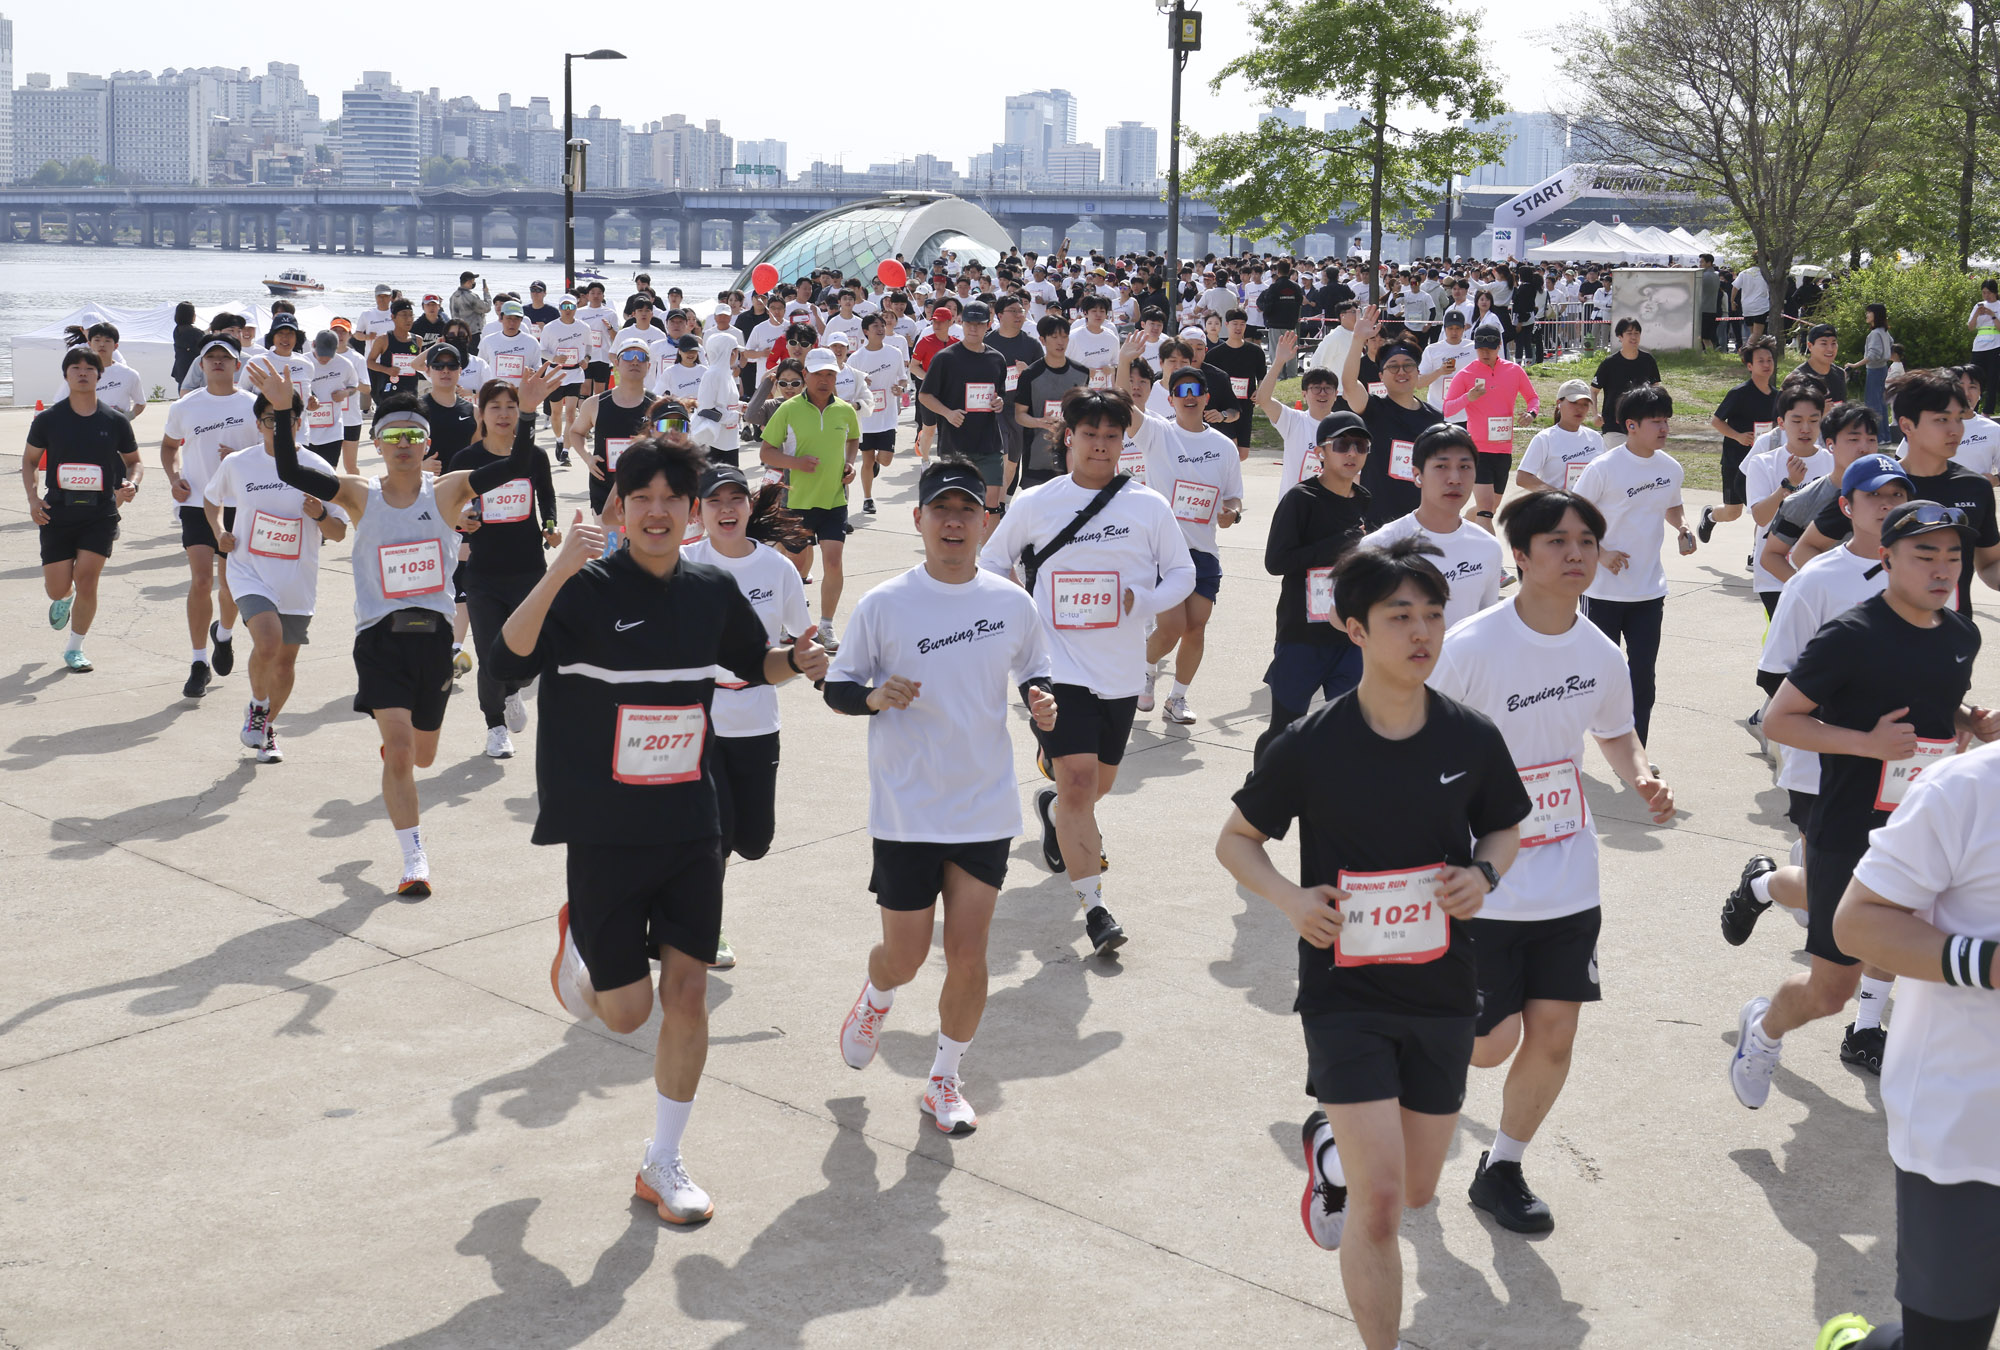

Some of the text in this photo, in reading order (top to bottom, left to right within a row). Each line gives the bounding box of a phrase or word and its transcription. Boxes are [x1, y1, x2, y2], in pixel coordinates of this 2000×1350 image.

[1512, 180, 1564, 217] START
[194, 417, 244, 435] Burning Run
[1204, 451, 1220, 459] Run
[1562, 451, 1586, 462] Burning
[1876, 458, 1893, 471] LA
[246, 482, 284, 492] Burning
[1627, 477, 1671, 497] Burning Run
[496, 494, 526, 504] 3078
[1187, 496, 1210, 507] 1248
[266, 531, 296, 542] 1208
[1103, 525, 1130, 537] Run
[400, 559, 435, 574] 1038
[1457, 562, 1482, 575] Run
[748, 588, 774, 600] Run
[1072, 593, 1111, 605] 1819
[917, 630, 975, 654] Burning
[975, 619, 1005, 636] Run
[1507, 687, 1564, 712] Burning
[1565, 675, 1597, 693] Run
[628, 733, 695, 750] M 2077
[1893, 767, 1906, 777] M
[1535, 789, 1571, 810] 107
[1554, 820, 1575, 833] E-79
[1346, 882, 1386, 891] BURNING
[1388, 880, 1408, 888] RUN
[1349, 901, 1432, 926] M 1021
